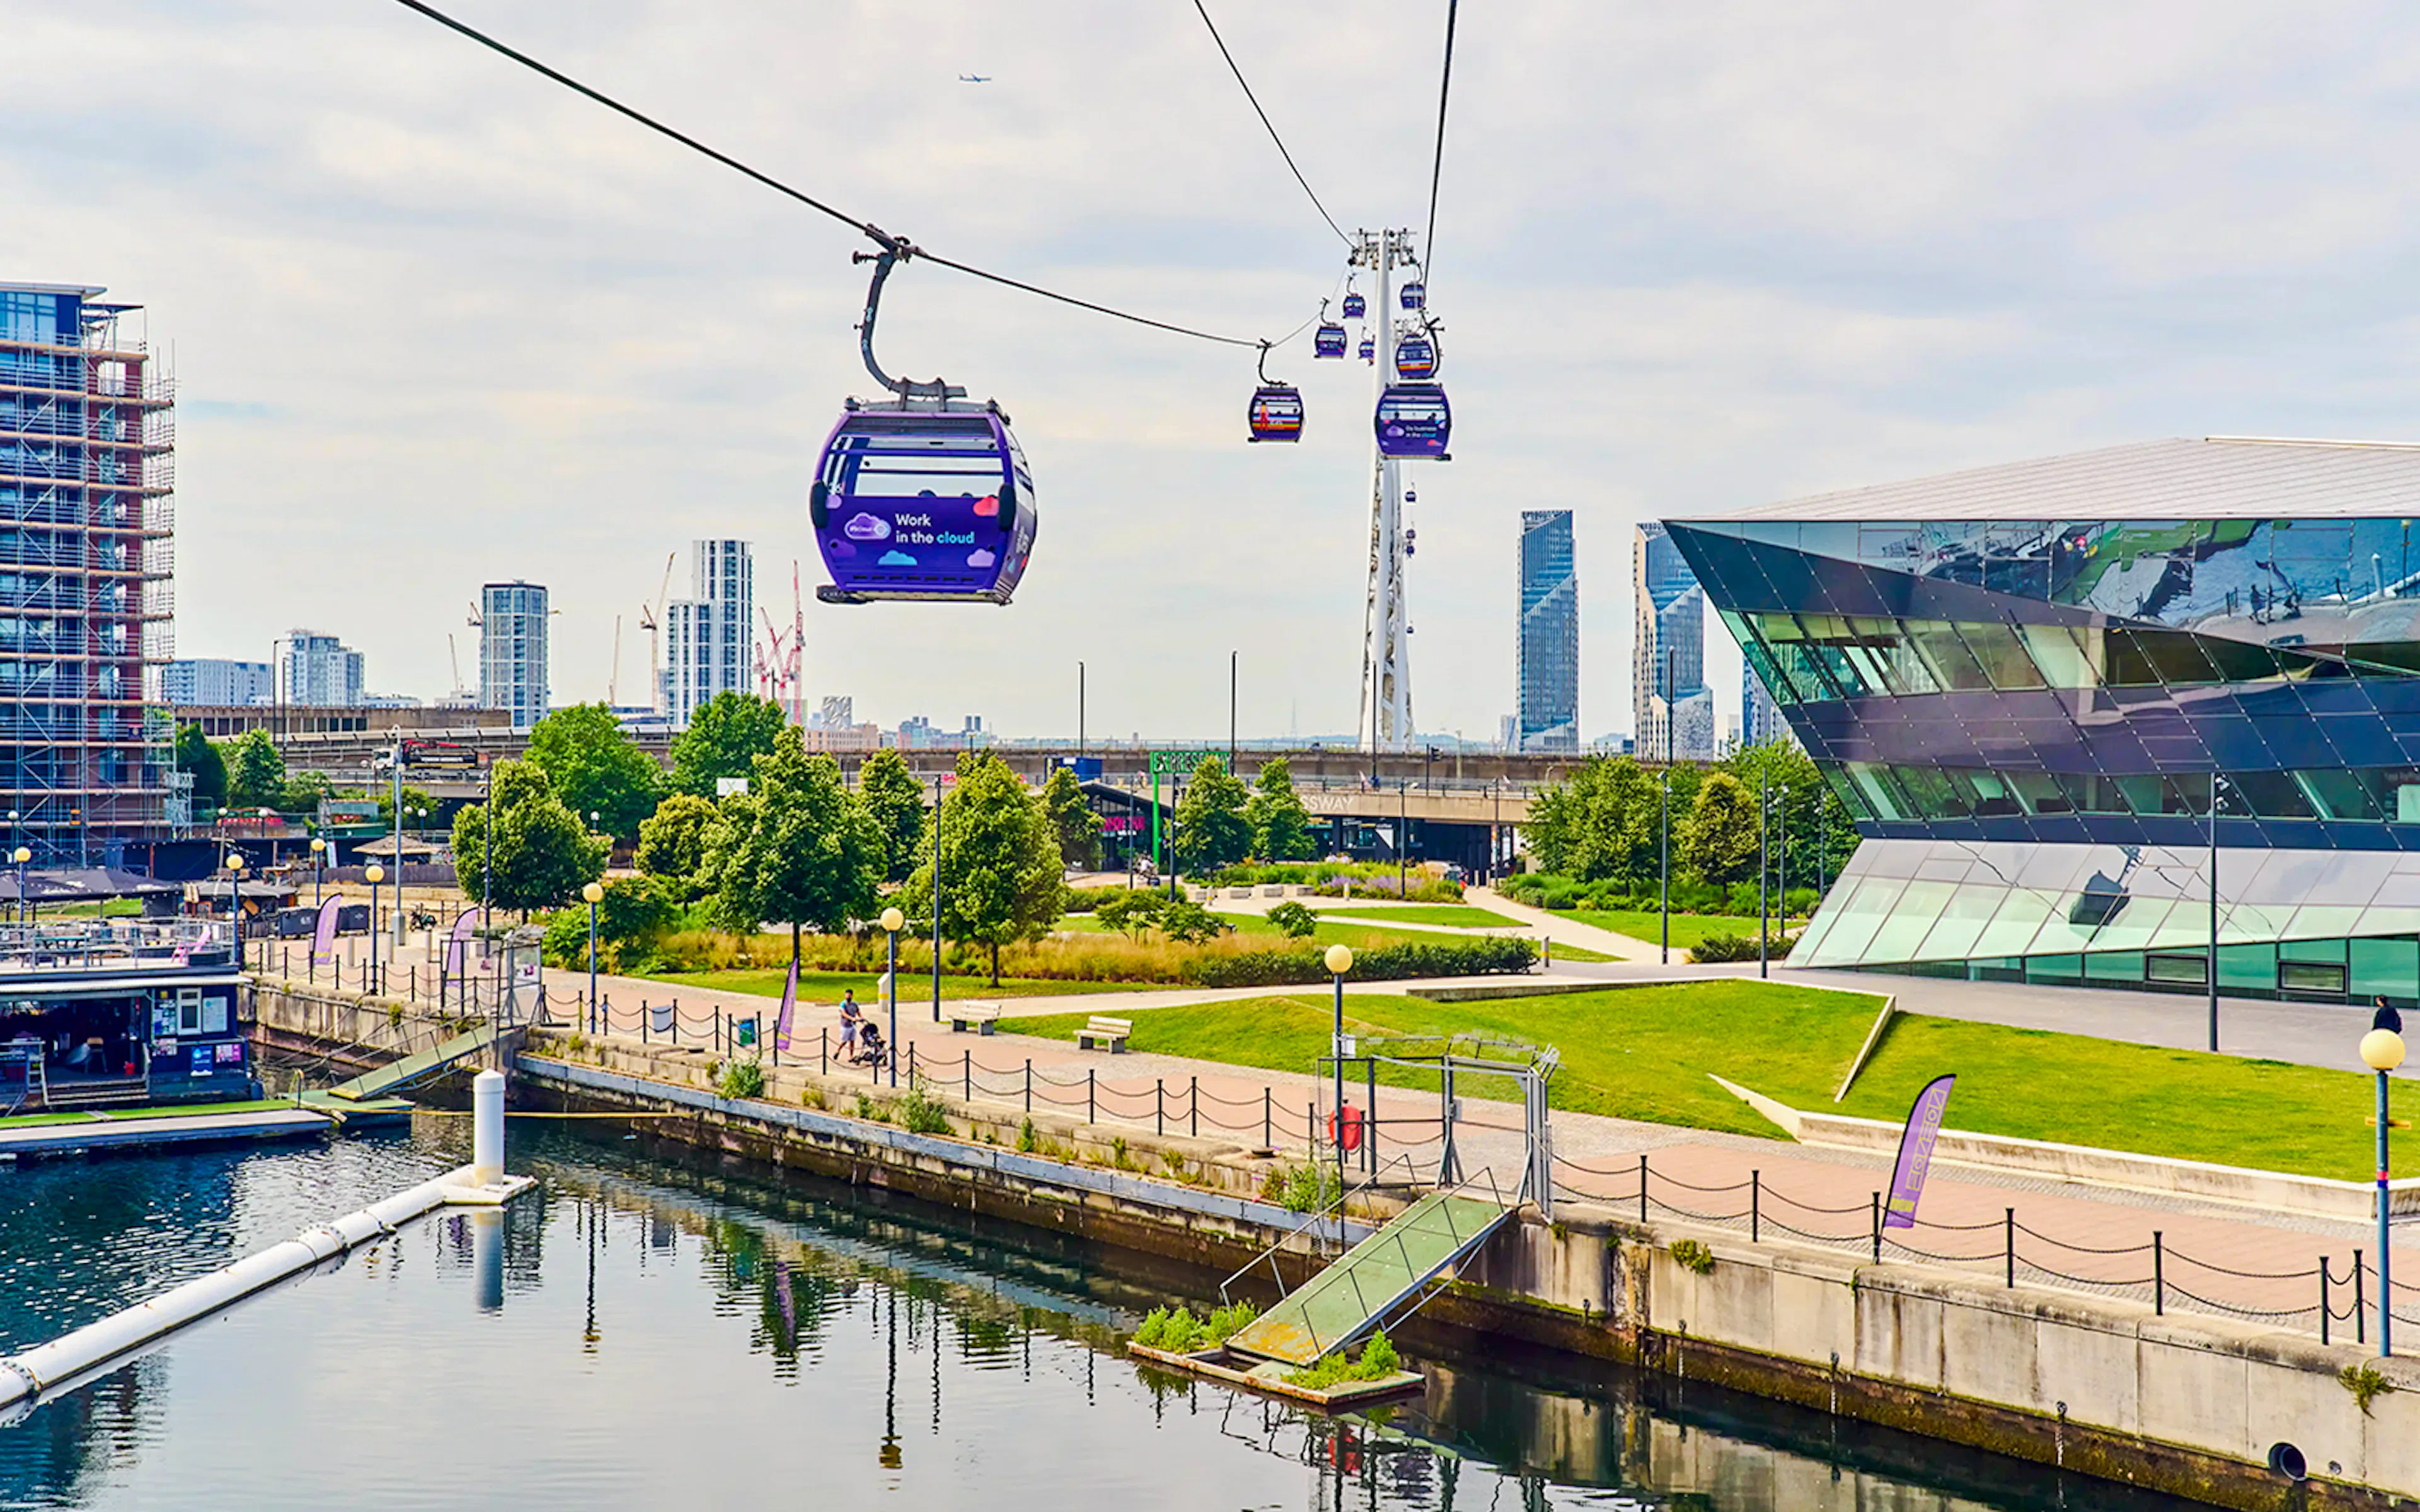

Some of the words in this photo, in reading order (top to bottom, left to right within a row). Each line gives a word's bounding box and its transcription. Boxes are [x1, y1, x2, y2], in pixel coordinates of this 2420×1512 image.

[895, 513, 931, 527] Work
[896, 530, 908, 544] in
[911, 530, 934, 544] the
[936, 531, 975, 544] cloud
[1300, 795, 1354, 811] SSWAY
